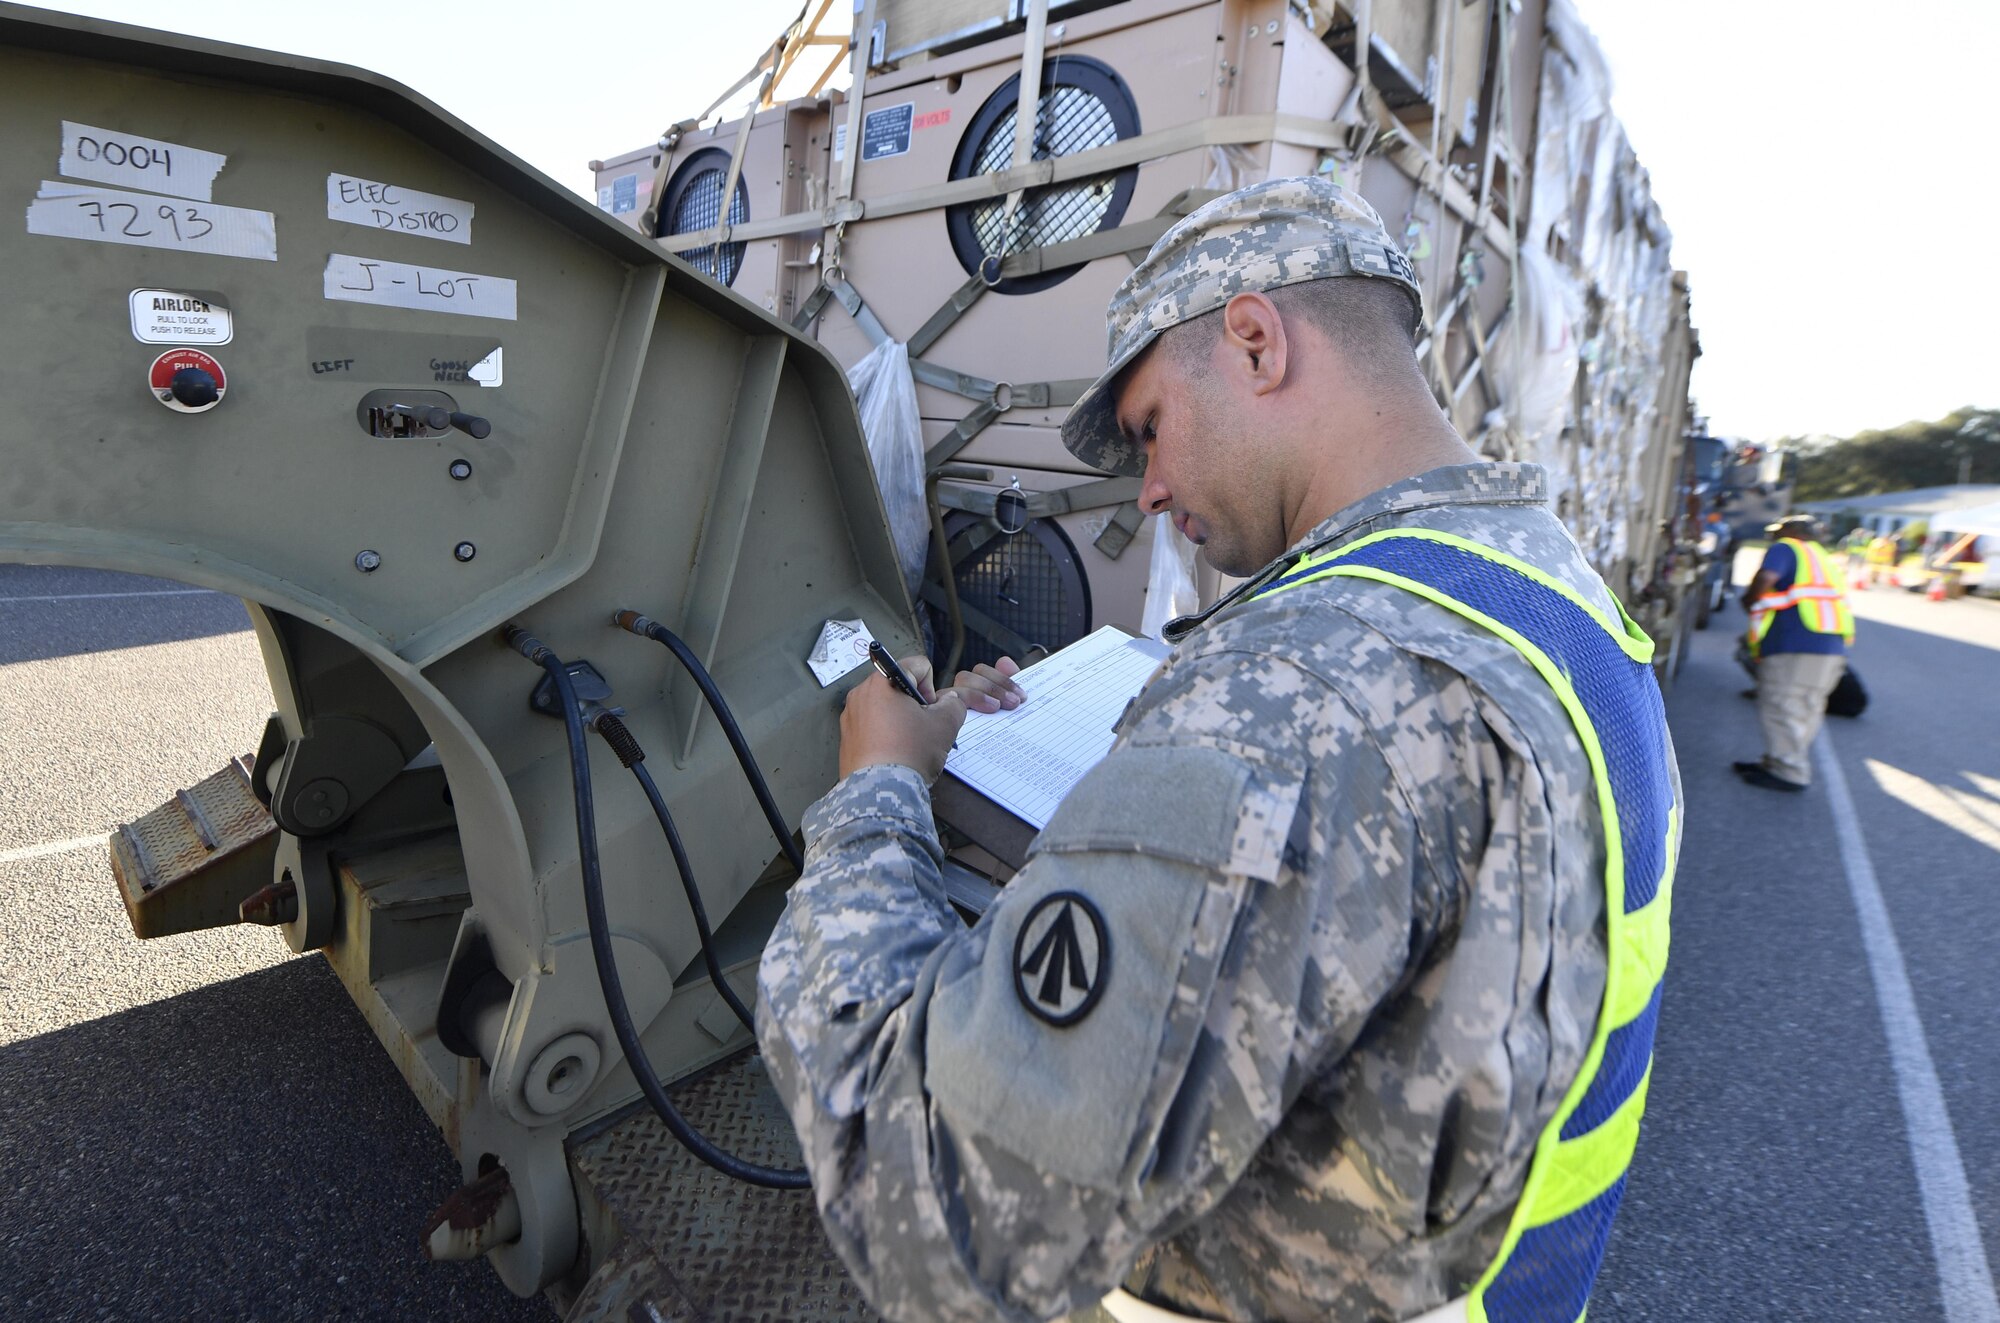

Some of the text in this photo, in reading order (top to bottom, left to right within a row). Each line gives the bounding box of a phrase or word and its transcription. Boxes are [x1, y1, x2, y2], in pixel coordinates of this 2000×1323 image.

[77, 136, 171, 177] 0004
[78, 202, 213, 242] 7293
[371, 209, 459, 233] DISTRO
[152, 298, 211, 313] AIRLOCK
[157, 315, 209, 325] PULL TO LOCK
[152, 325, 217, 336] PUSH TO RELEASE
[162, 352, 187, 364] EXHAUST
[199, 356, 212, 365] BAG
[311, 359, 355, 375] LIFT
